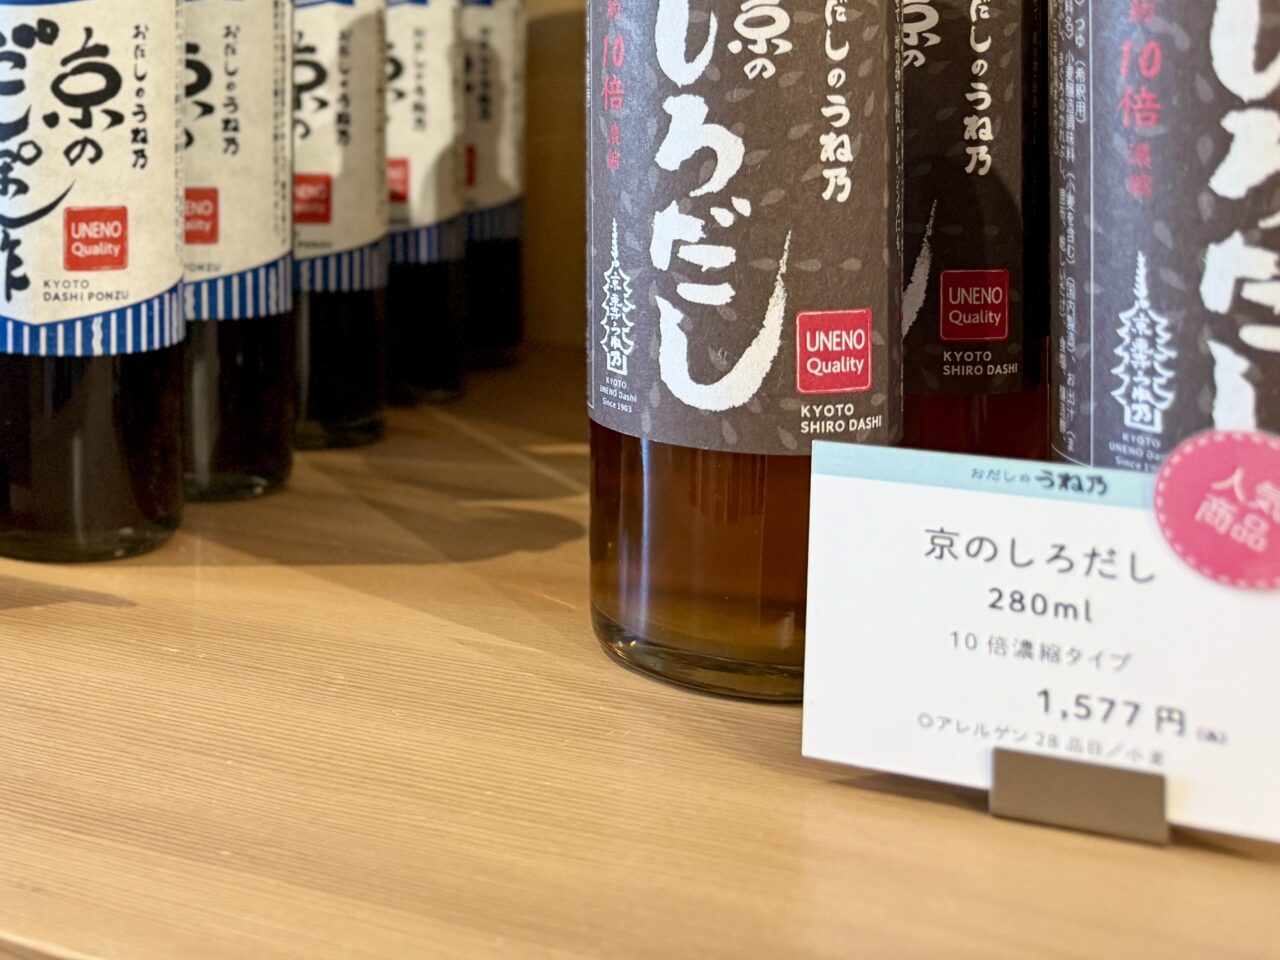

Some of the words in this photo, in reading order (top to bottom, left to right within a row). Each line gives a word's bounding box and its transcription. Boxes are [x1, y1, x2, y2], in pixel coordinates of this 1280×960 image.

[42, 26, 125, 167] 京の
[132, 24, 150, 170] おだしのうね乃
[71, 219, 123, 239] UNENO
[71, 242, 121, 258] Quality
[43, 279, 90, 289] KYOTO
[42, 291, 84, 303] DASHI
[88, 290, 129, 302] PONZU
[948, 286, 1003, 305] UNENO
[948, 309, 1002, 327] Quality
[806, 328, 866, 353] UNENO
[943, 350, 992, 362] KYOTO
[806, 356, 865, 377] Quality
[943, 364, 984, 376] SHIRO
[986, 362, 1018, 375] DASHI
[605, 376, 627, 389] KYOTO
[602, 396, 617, 410] Since
[618, 391, 637, 403] Dashi
[800, 403, 855, 418] KYOTO
[800, 419, 846, 434] SHIRO
[848, 414, 882, 432] DASHI
[1193, 492, 1269, 553] 商品
[924, 527, 1155, 584] 京のしろだし
[987, 587, 1093, 623] 280ml
